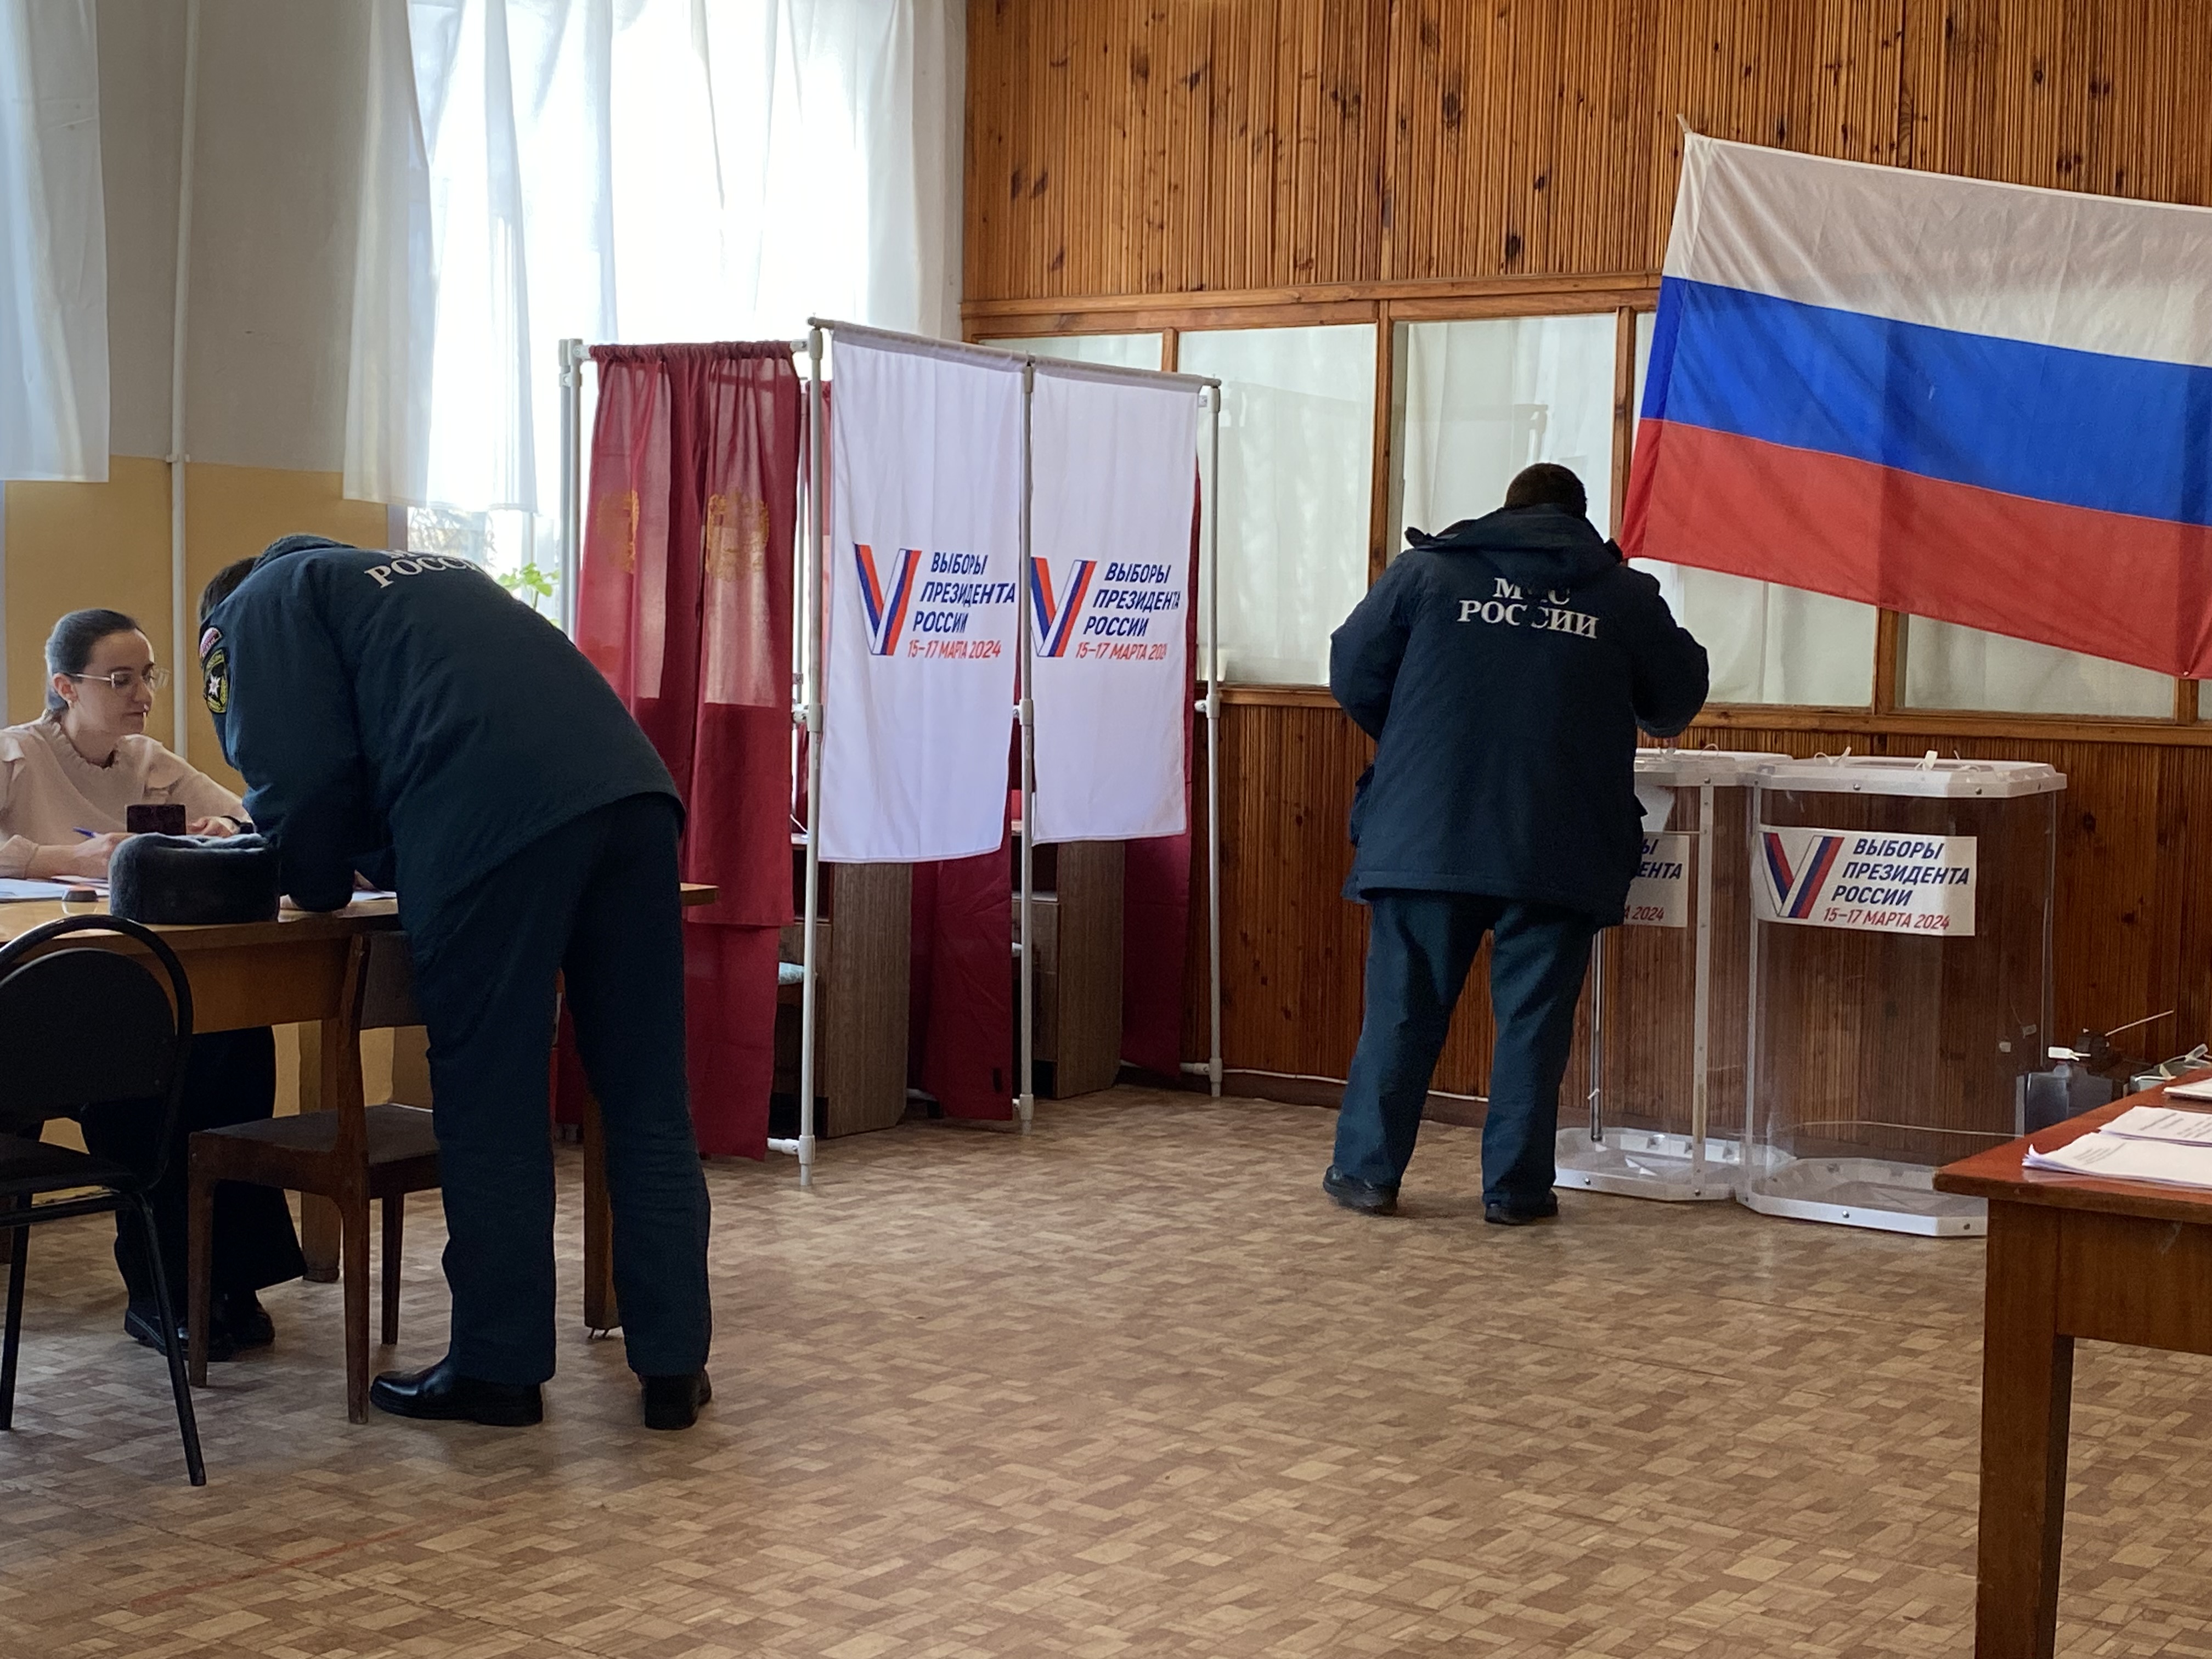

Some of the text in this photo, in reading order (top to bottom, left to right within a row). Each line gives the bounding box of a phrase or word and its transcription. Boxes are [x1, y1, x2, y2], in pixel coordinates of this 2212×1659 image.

[930, 552, 988, 575] ВЫБОРЫ
[1104, 562, 1172, 584] ВЫБОРЫ
[919, 582, 1015, 607] ПРЕЗИДЕНТА
[912, 611, 969, 634] РОССИИ
[1083, 616, 1149, 637] РОССИИ
[939, 640, 966, 658] МАРТА
[967, 640, 1002, 659] 2024
[1109, 643, 1147, 660] МАРТА
[1852, 838, 1945, 860] ВЫБОРЫ
[1842, 861, 1970, 885] ПРЕЗИДЕНТА
[1831, 885, 1914, 906] РОССИИ
[1632, 906, 1664, 921] 2024
[1862, 910, 1912, 928] МАРТА
[1914, 913, 1951, 930] 2024
